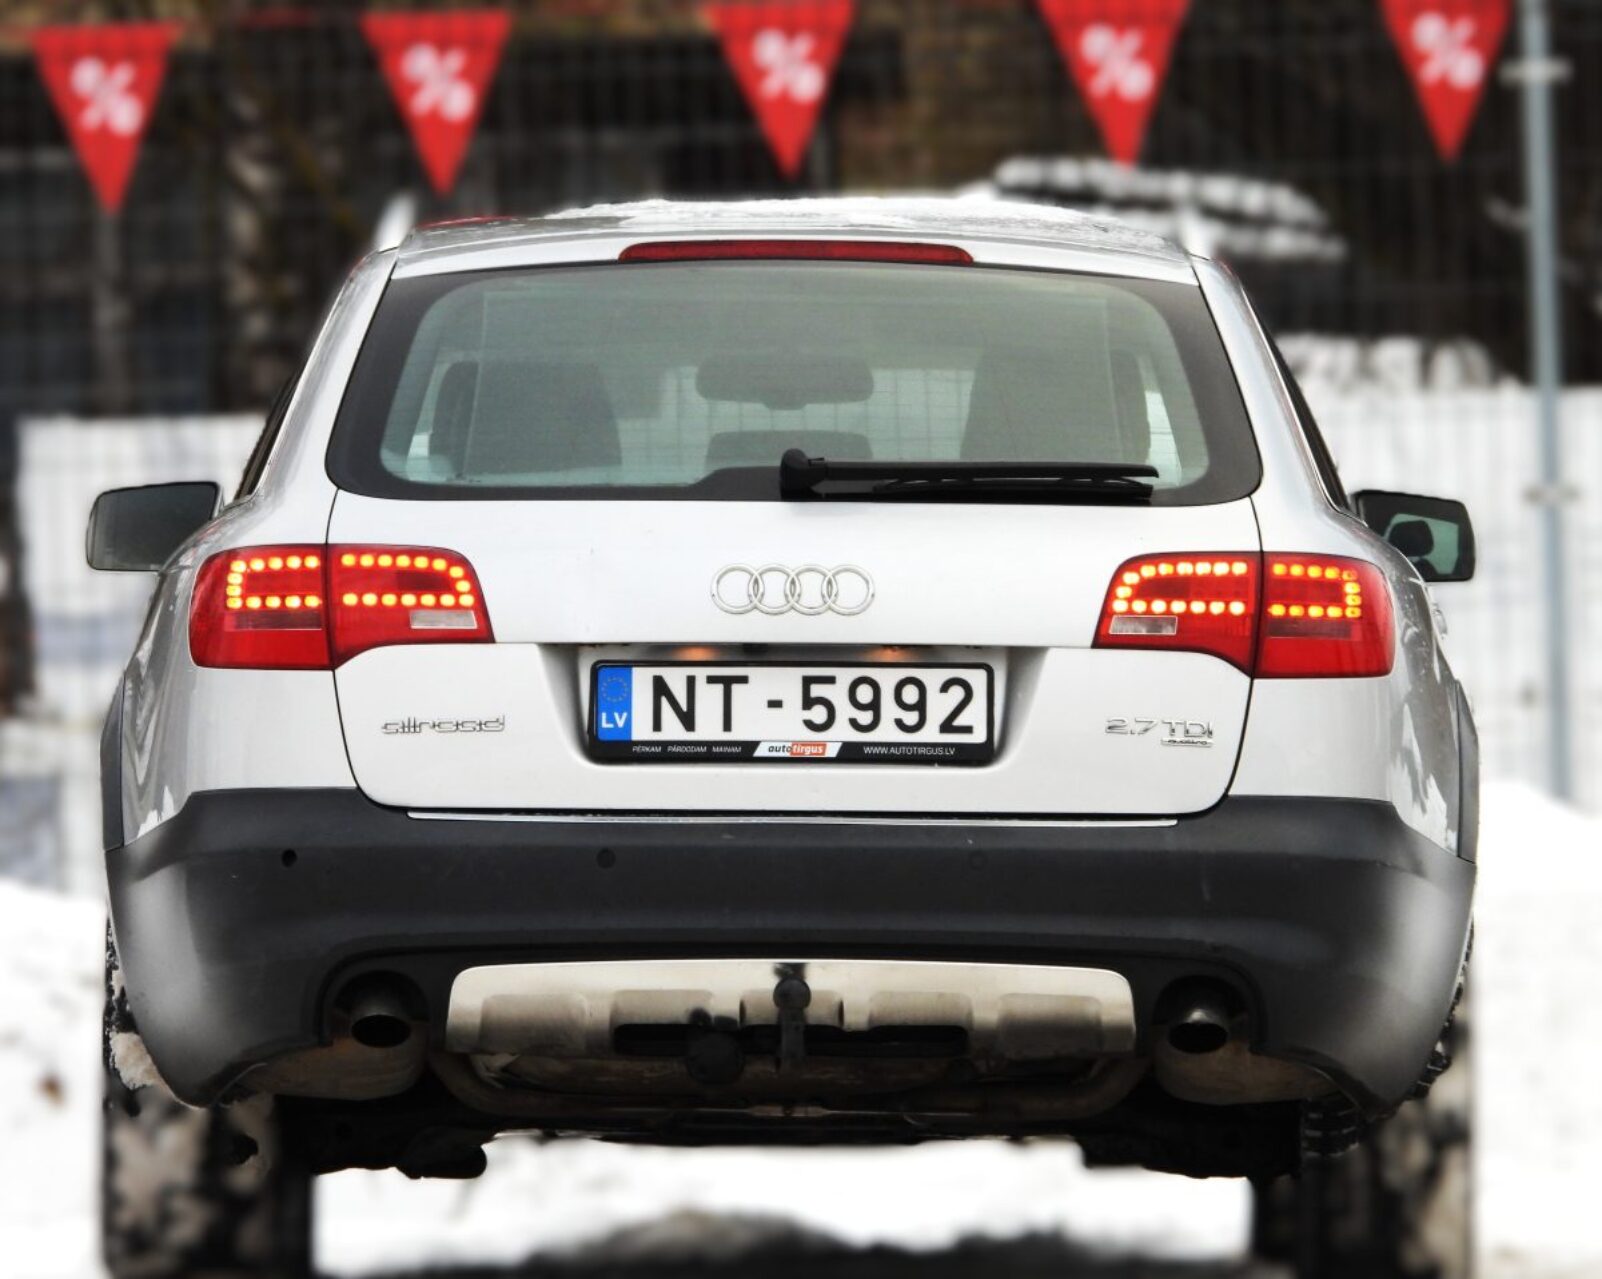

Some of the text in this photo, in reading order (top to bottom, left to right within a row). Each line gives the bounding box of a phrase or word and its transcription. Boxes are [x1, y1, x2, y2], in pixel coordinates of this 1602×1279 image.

[403, 43, 474, 121] %
[752, 27, 826, 103] %
[1081, 23, 1153, 101] %
[1411, 11, 1483, 90] %
[71, 57, 142, 136] %
[381, 714, 506, 735] allroad
[601, 711, 628, 729] LV
[863, 745, 956, 756] WWW.AUTOTIRGUS.LV
[1105, 717, 1214, 739] 2.7 TDI
